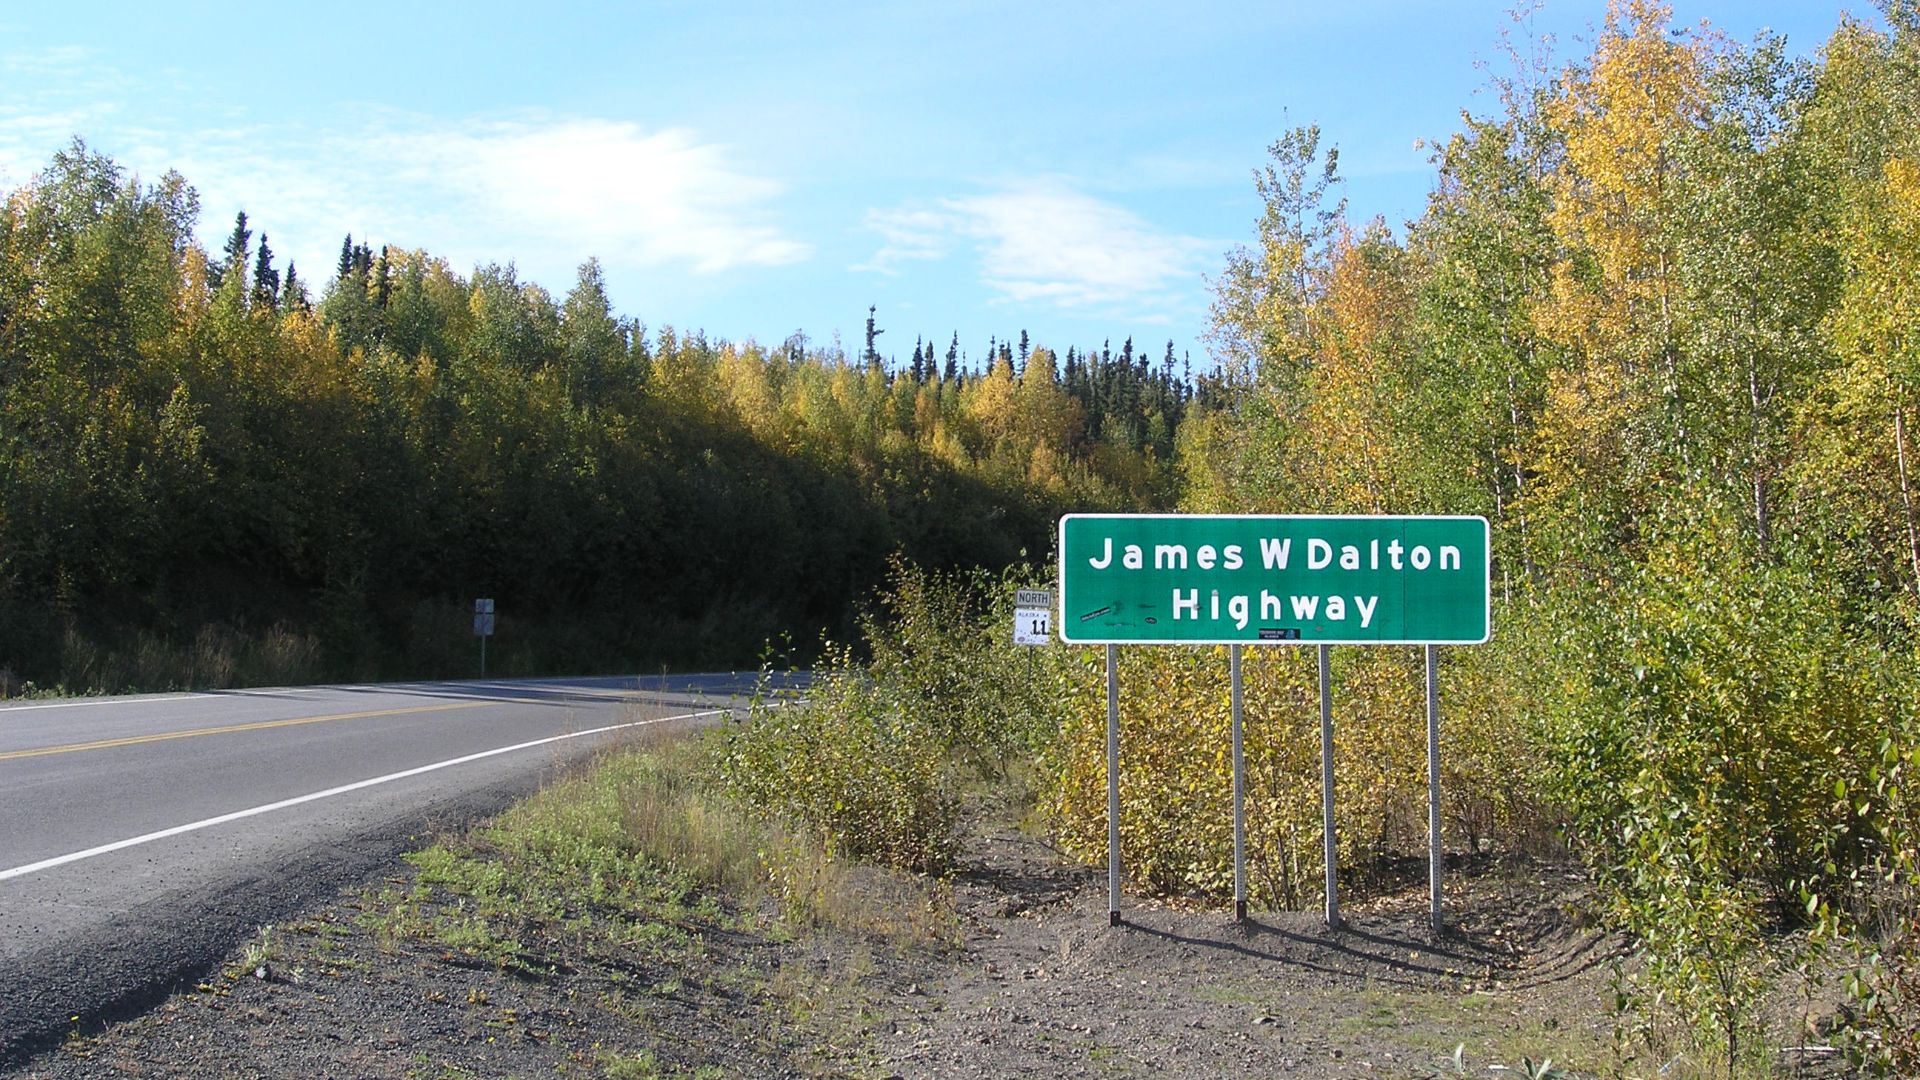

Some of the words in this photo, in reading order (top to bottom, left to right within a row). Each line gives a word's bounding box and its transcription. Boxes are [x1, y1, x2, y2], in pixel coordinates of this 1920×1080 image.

[1088, 537, 1244, 570] James
[1259, 538, 1291, 570] W
[1307, 538, 1461, 570] Dalton
[1019, 592, 1048, 603] NORTH
[1172, 588, 1378, 631] Highway
[1032, 619, 1048, 636] 11
